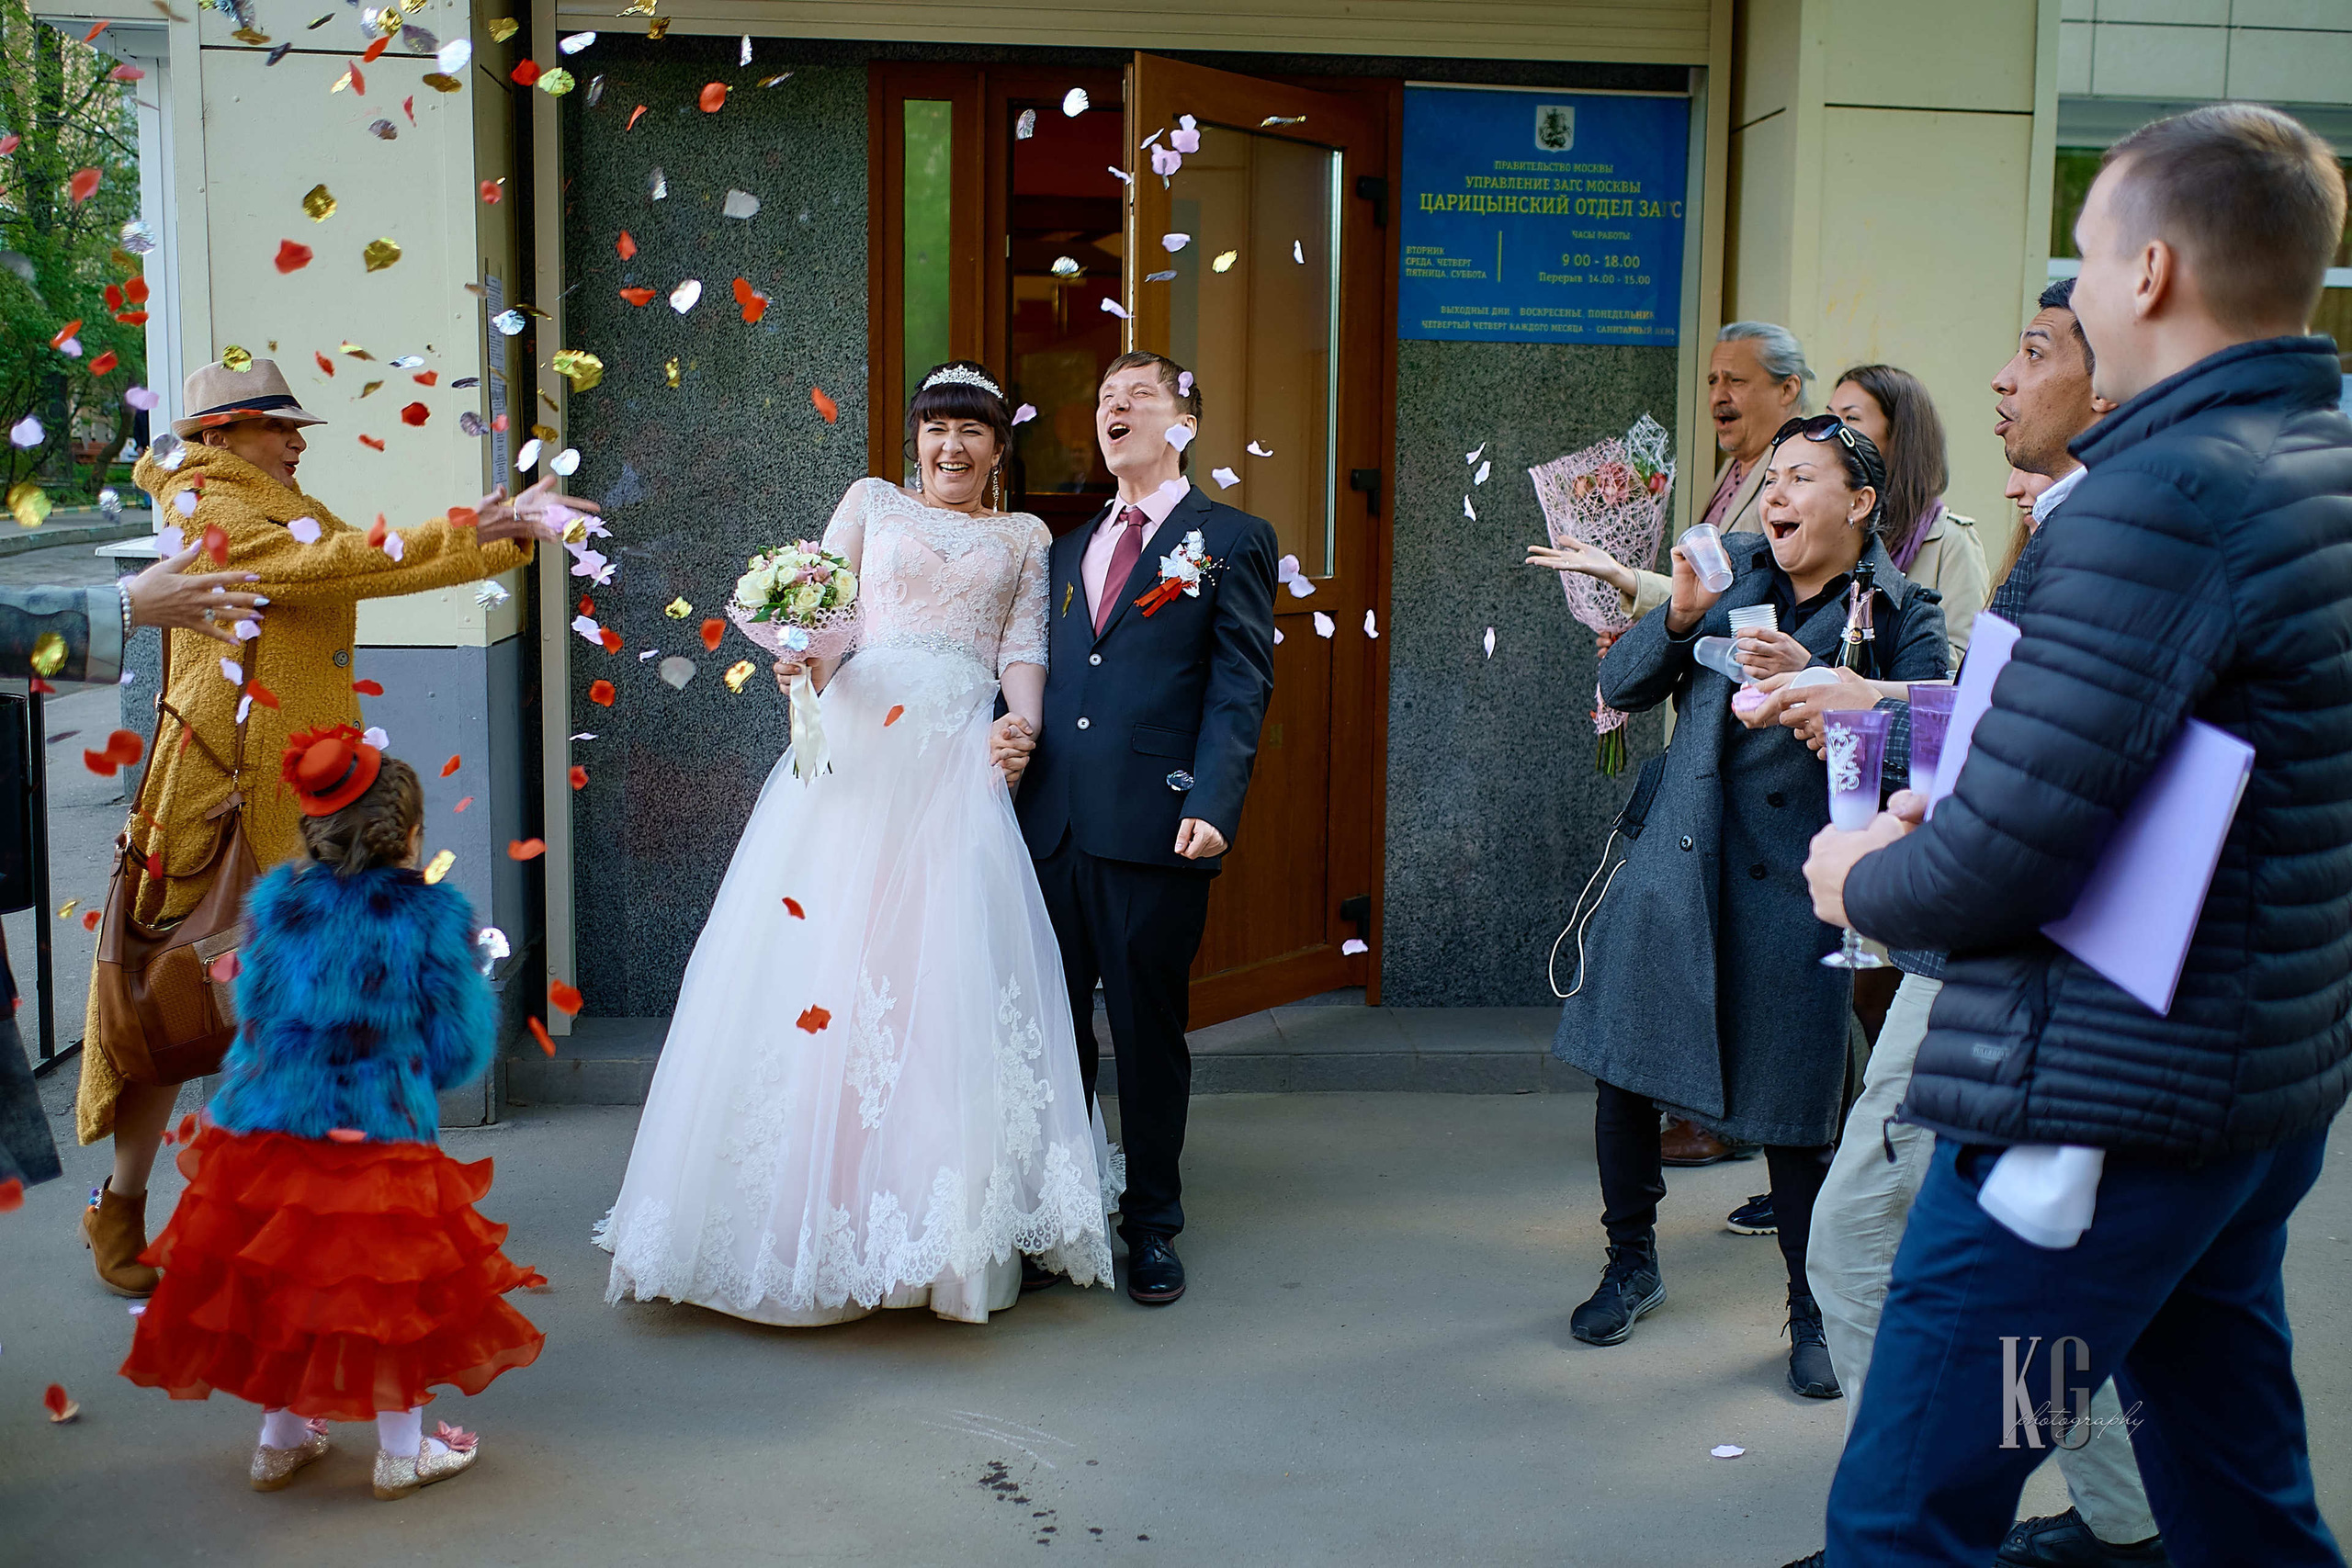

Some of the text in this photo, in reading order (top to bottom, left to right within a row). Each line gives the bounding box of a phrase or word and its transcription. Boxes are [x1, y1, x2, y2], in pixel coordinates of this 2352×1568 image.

[1495, 161, 1614, 174] ПРАВИТЕЛЬСТВО МОСКВЫ
[1465, 175, 1641, 194] УПРАВЛЕНИЕ ЗАГС МОСКВЫ
[1419, 192, 1682, 219] ЦАРИЦЫНСКИЙ ОТДЕЛ ЗАГС
[1572, 231, 1596, 240] ЧАСЫ
[1406, 245, 1445, 255] ВТОРНИК
[1437, 258, 1473, 267] ЧЕТВЕРГ
[1604, 254, 1641, 268] 18.00
[1451, 269, 1487, 279] СУББОТА
[1539, 272, 1583, 284] Перерыв
[1589, 274, 1615, 284] 14.00
[1624, 275, 1651, 285] 15.00
[1441, 305, 1489, 316] ВЫХОДНЫЕ
[1421, 320, 1470, 329] ЧЕТВЕРТЫЙ
[1473, 321, 1508, 331] ЧЕТВЕРГ
[1510, 322, 1549, 333] КАЖДОГО
[1551, 324, 1584, 333] МЕСЯЦА
